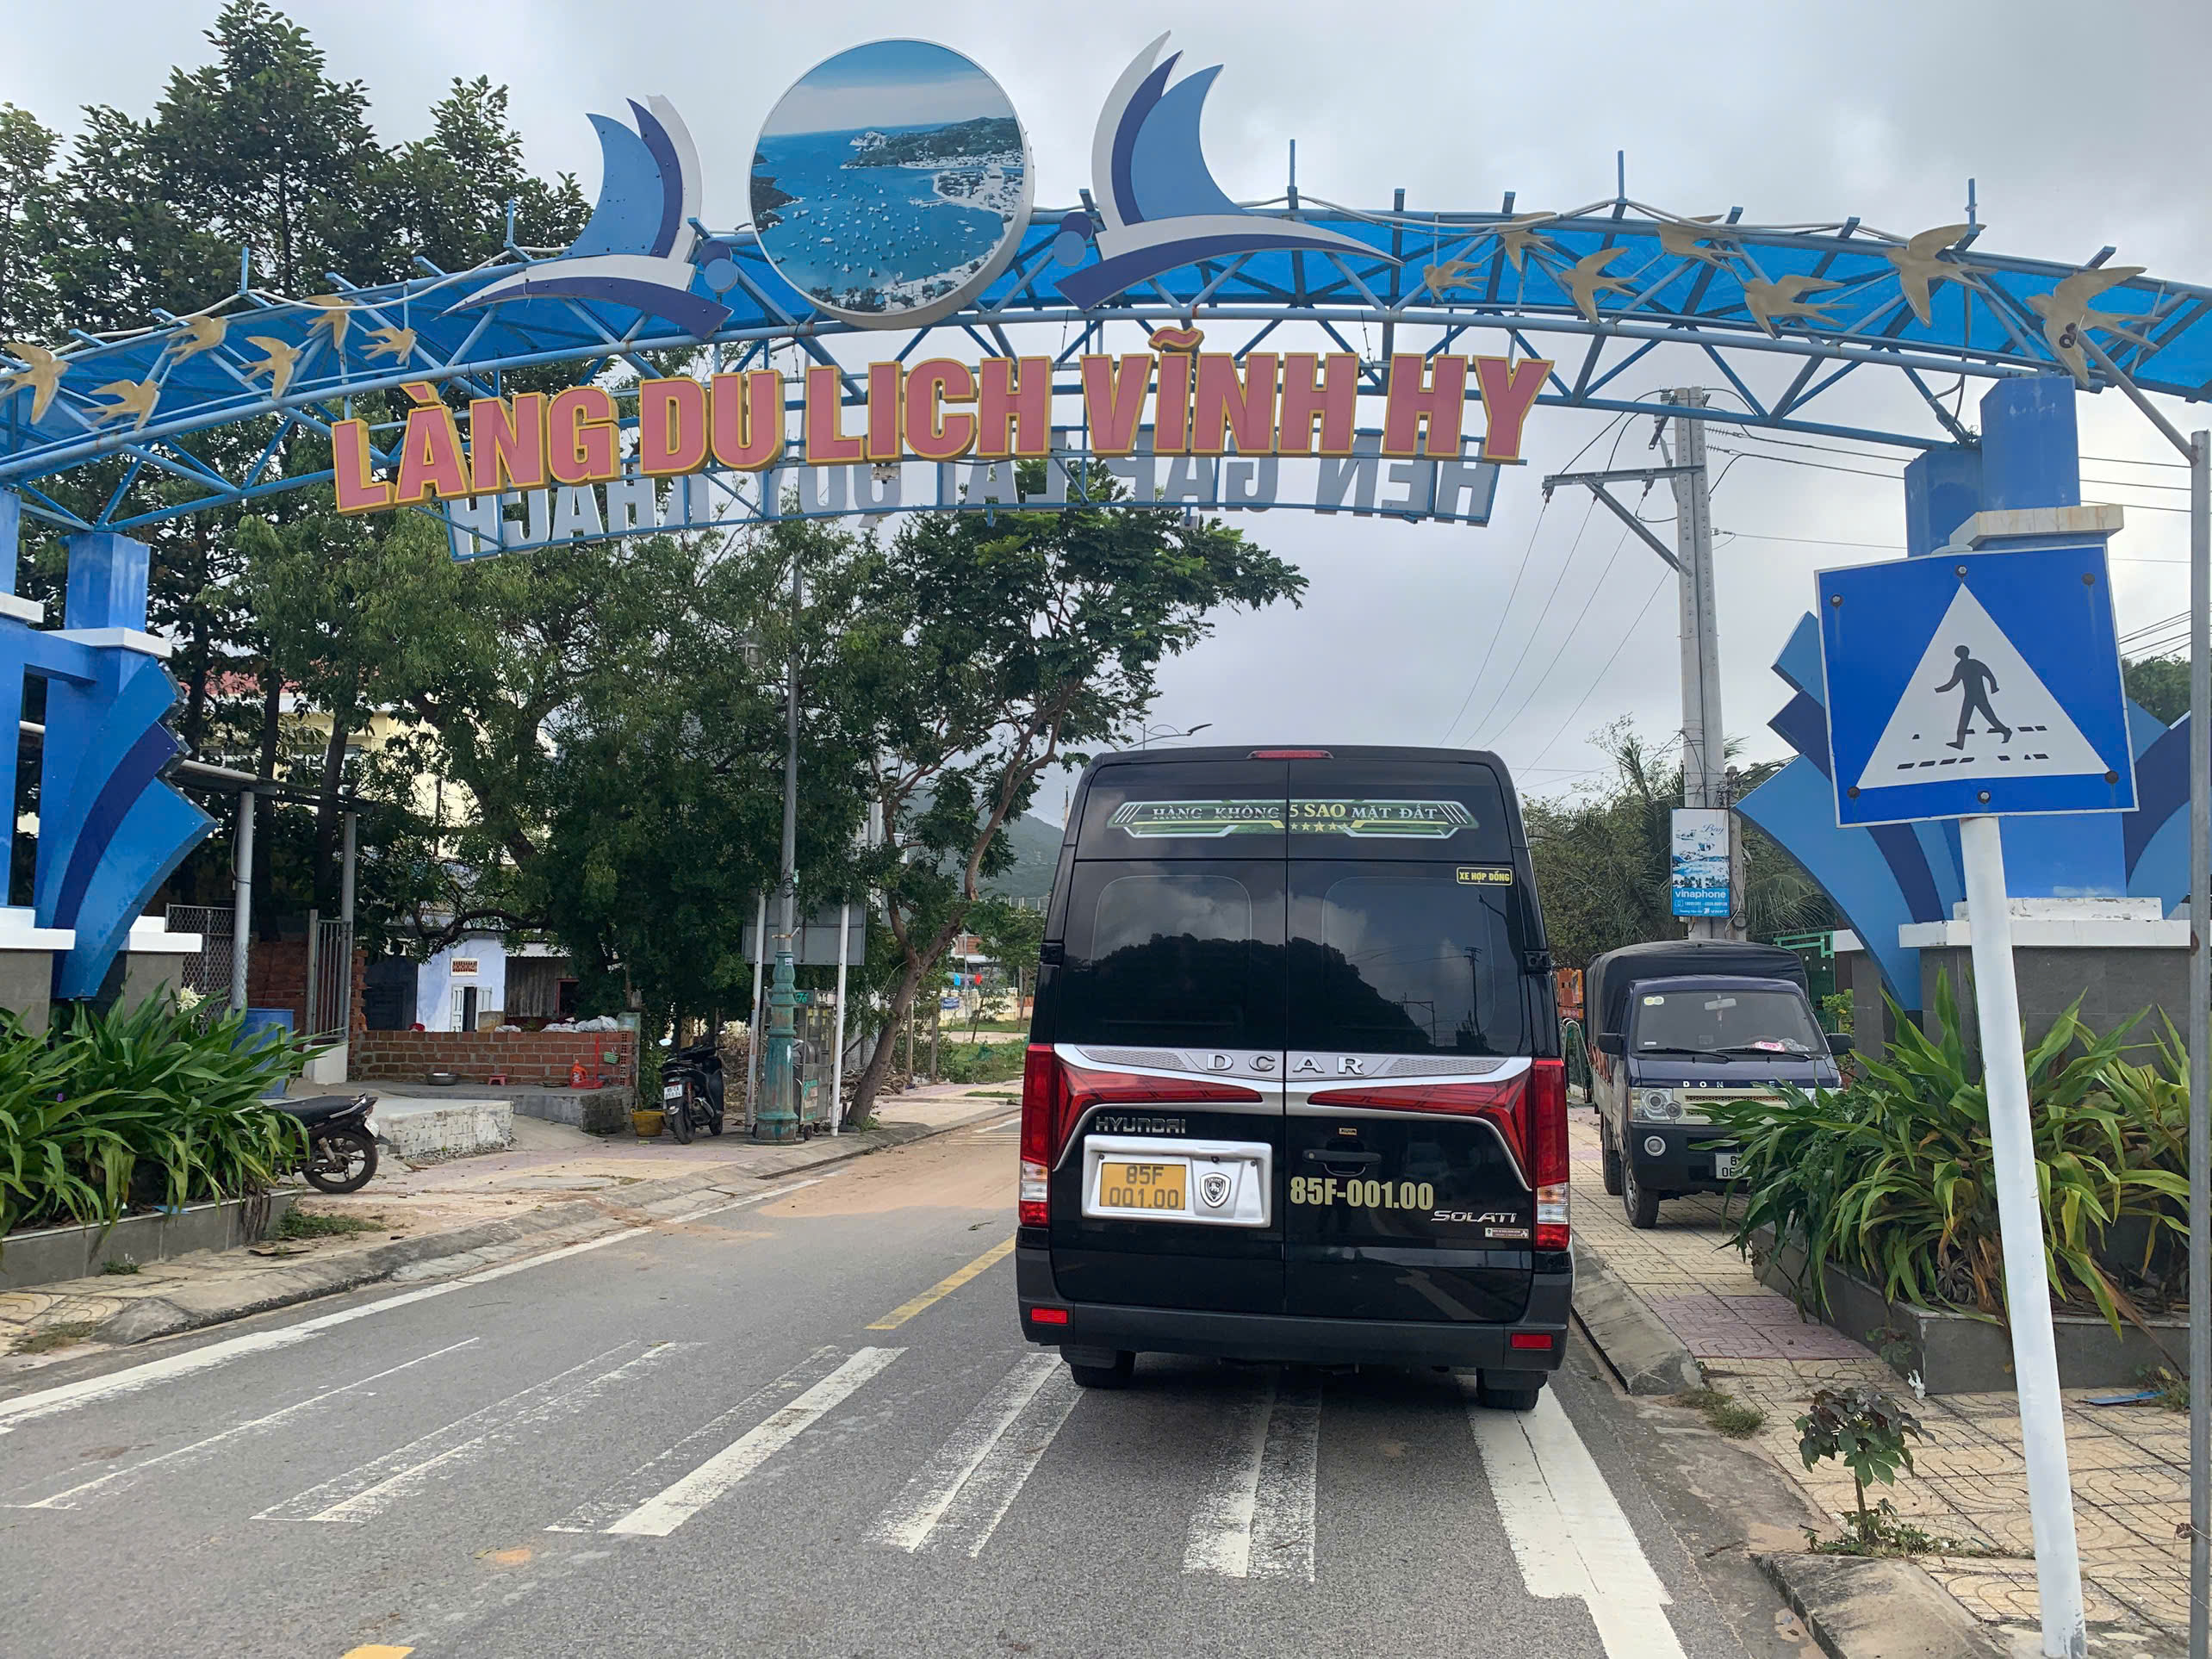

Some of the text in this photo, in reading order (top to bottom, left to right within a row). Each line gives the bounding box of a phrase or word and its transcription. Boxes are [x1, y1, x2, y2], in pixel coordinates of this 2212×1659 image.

[331, 381, 621, 516] LÀNG
[638, 369, 785, 475] DU
[1078, 326, 1360, 459] VĨNH
[1381, 353, 1556, 465] HY
[1153, 803, 1438, 820] HÀNG KHÔNG 5 SAO MẶT ĐẤT
[1459, 871, 1469, 880] XE
[1470, 872, 1487, 883] HỢP
[1675, 889, 1727, 899] vinaphone
[1207, 1053, 1364, 1075] DCAR
[1095, 1115, 1186, 1134] HYUNDAI
[1126, 1165, 1165, 1185] 85F
[1109, 1187, 1179, 1209] 001.00
[1289, 1176, 1434, 1211] 85F-001.00
[1430, 1209, 1518, 1223] SOLATI
